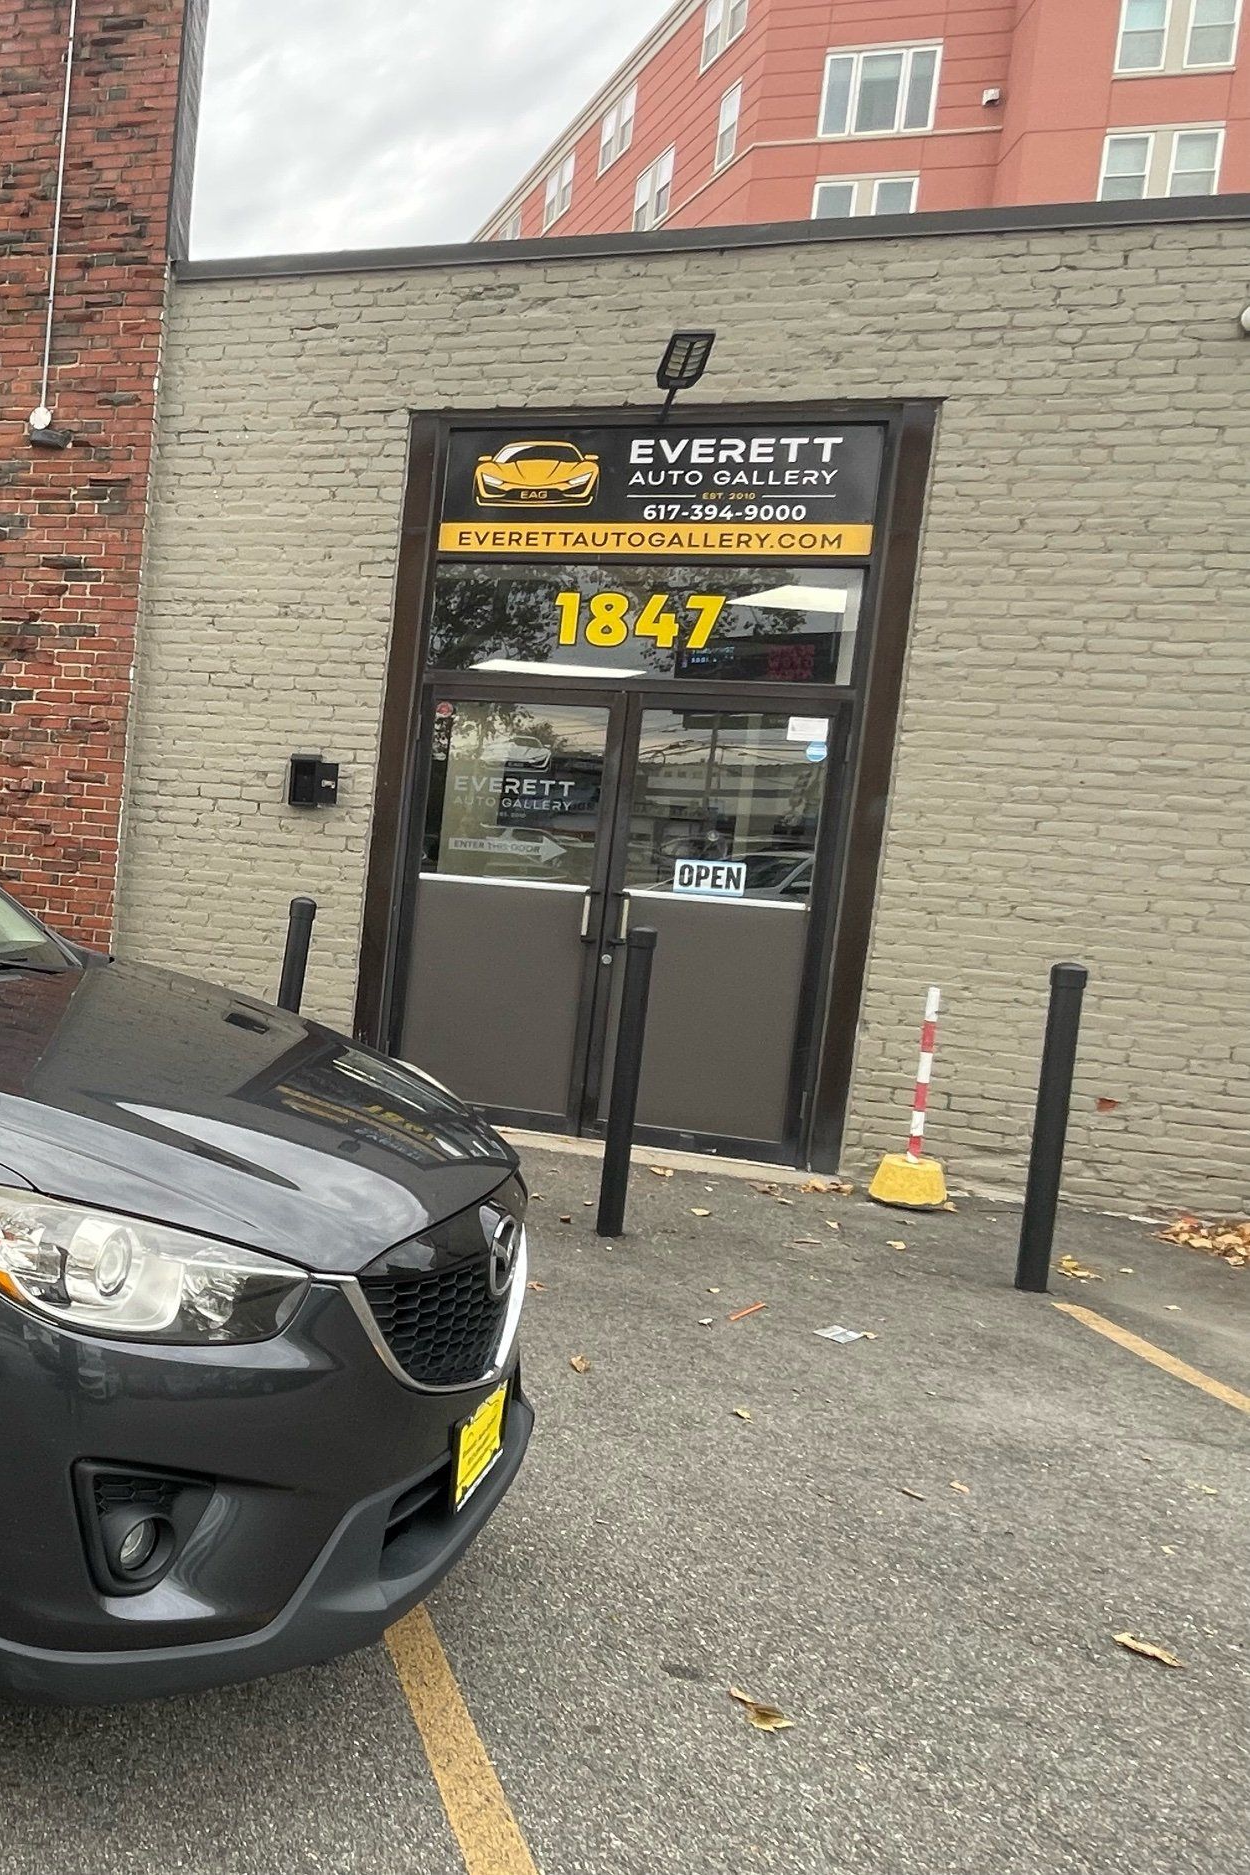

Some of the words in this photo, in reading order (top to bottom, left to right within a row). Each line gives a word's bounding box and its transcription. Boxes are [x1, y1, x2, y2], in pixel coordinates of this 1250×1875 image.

[629, 437, 844, 465] EVERETT
[628, 470, 703, 486] AUTO
[713, 470, 839, 486] GALLERY
[520, 490, 548, 500] EAG
[729, 492, 756, 500] 2010
[643, 505, 807, 521] 617-394-9000
[458, 531, 843, 550] EVERETTAUTOGALLERY.COM
[555, 592, 726, 649] 1847
[454, 776, 575, 797] EVERETT
[454, 796, 496, 808] AUTO
[501, 797, 573, 812] GALLERY
[454, 840, 484, 849] ENTER
[510, 844, 540, 853] DOOR
[678, 864, 742, 891] OPEN
